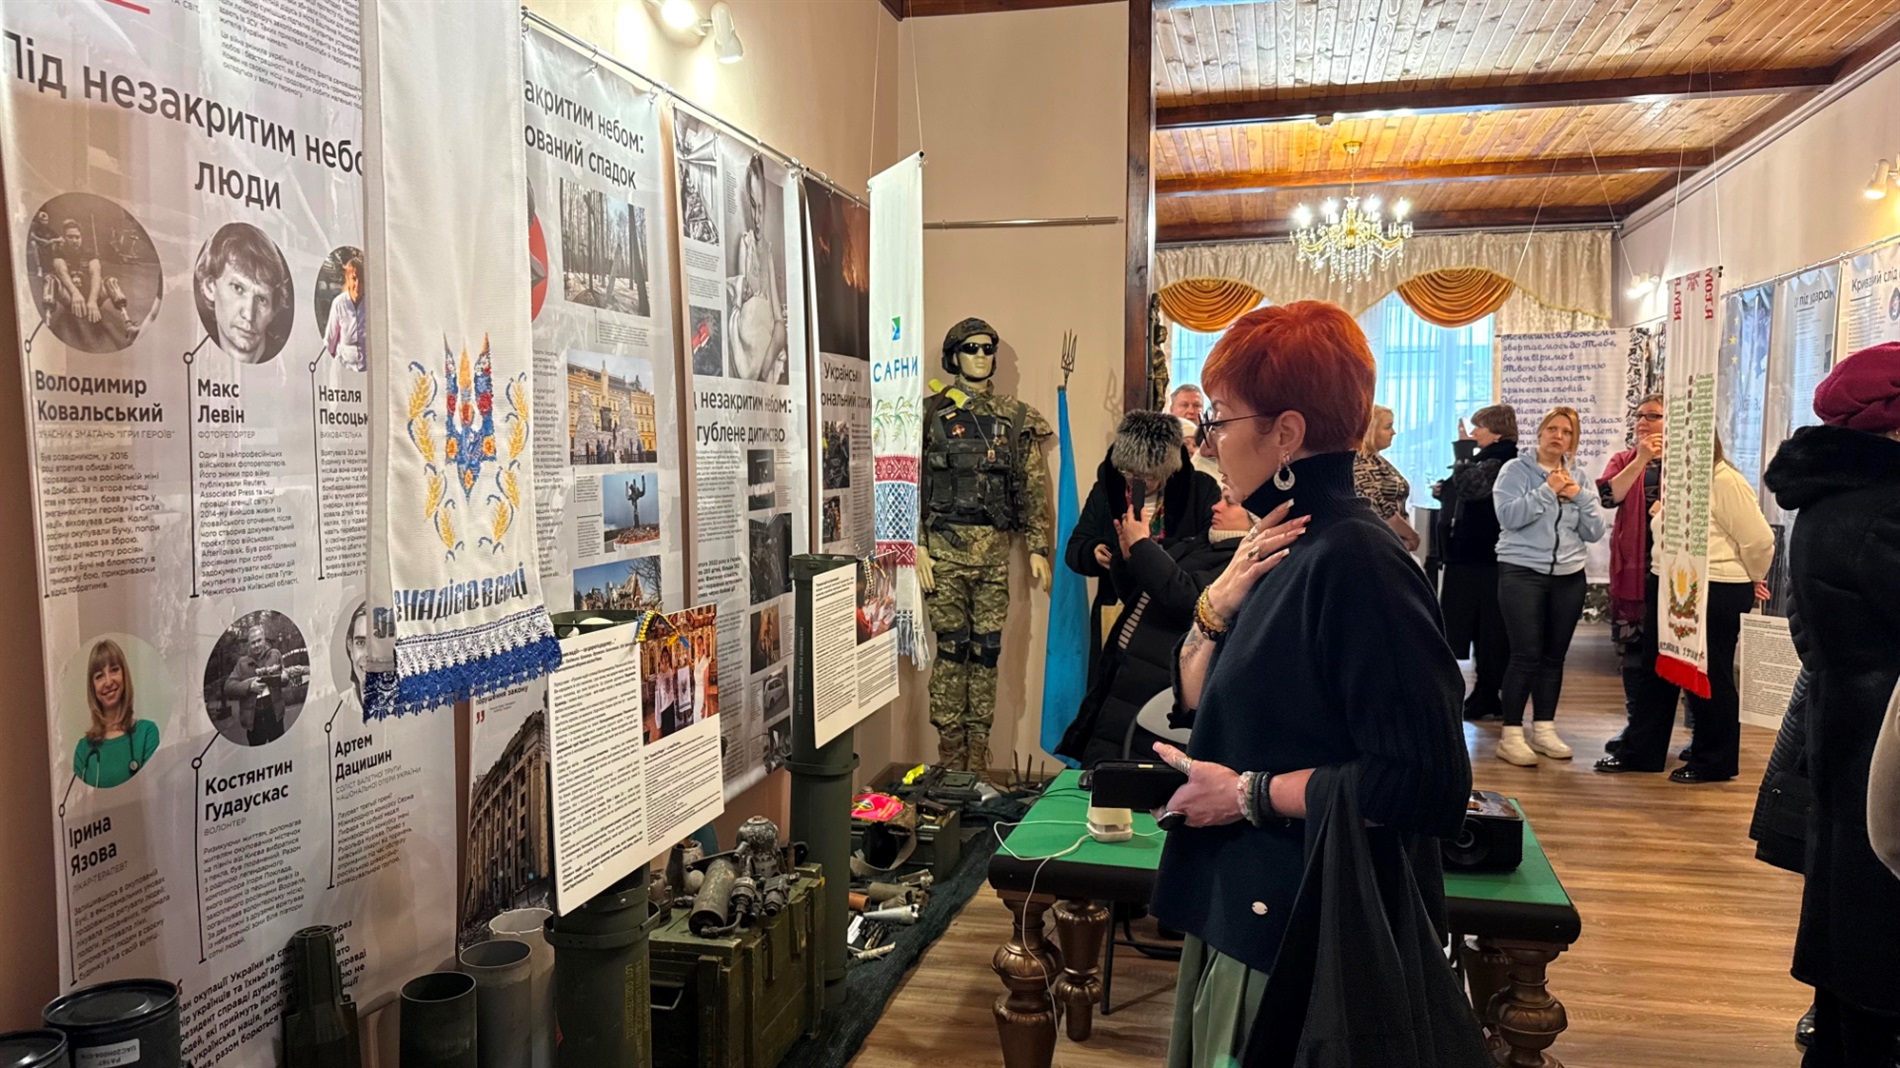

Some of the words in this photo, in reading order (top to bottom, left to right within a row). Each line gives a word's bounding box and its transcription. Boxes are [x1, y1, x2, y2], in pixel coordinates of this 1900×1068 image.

[84, 65, 296, 156] незакритим
[524, 79, 594, 131] акритим
[598, 114, 644, 154] небом:
[524, 124, 584, 168] ований
[588, 151, 637, 190] спадок
[194, 161, 281, 210] люди
[873, 356, 918, 383] САРНИ
[35, 370, 147, 398] Володимир
[197, 378, 240, 398] Макс
[318, 385, 362, 403] Наталя
[37, 400, 163, 423] Ковальський
[197, 405, 245, 424] Левін
[700, 391, 763, 414] незакритим
[764, 393, 792, 414] небом:
[74, 429, 115, 439] ЗМАГАНЬ
[198, 430, 256, 439] ФОТОРЕПОРТЕР
[696, 421, 746, 446] гублене
[199, 451, 218, 460] Один
[199, 470, 217, 479] Його
[242, 470, 253, 479] про
[200, 490, 238, 499] Associated
[238, 488, 254, 497] Press
[334, 734, 372, 758] Артем
[205, 760, 293, 796] Костянтин
[335, 749, 392, 783] Дацишин
[205, 784, 289, 821] Гудаускас
[68, 816, 112, 850] Ірина
[204, 817, 247, 837] ВОЛОНТЕР
[269, 819, 302, 835] допомагав
[70, 842, 117, 877] Язова
[282, 845, 301, 855] Разом
[193, 975, 230, 1005] окупації
[230, 960, 264, 983] України
[266, 953, 275, 964] не
[180, 1012, 215, 1045] резидент
[217, 991, 251, 1018] справді
[252, 978, 278, 1001] думав,
[336, 945, 351, 957] ато
[192, 991, 231, 1021] українців
[233, 985, 243, 996] та
[245, 969, 269, 989] їхньої
[206, 1026, 218, 1039] які
[219, 1002, 259, 1032] приймуть
[260, 989, 278, 1006] його
[339, 948, 367, 967] правді
[194, 1028, 236, 1065] українська
[238, 1014, 262, 1033] нація,
[263, 998, 284, 1015] якою
[354, 963, 366, 974] не
[215, 1040, 240, 1063] разом
[241, 1014, 280, 1044] борються
